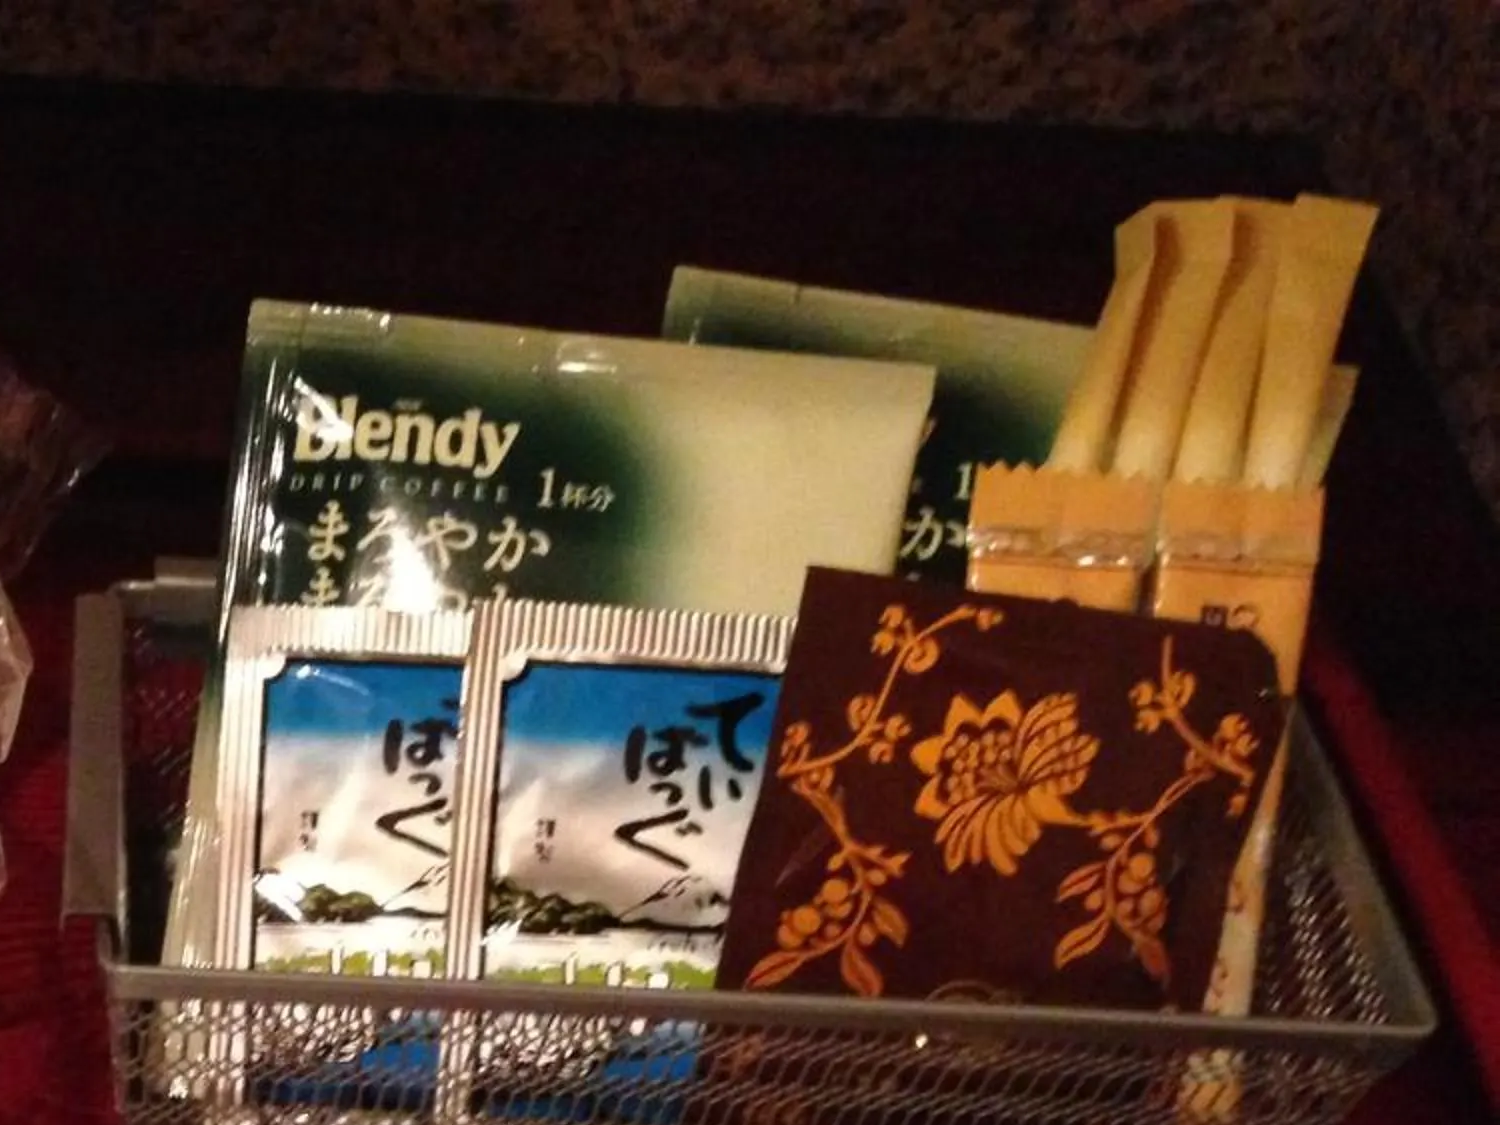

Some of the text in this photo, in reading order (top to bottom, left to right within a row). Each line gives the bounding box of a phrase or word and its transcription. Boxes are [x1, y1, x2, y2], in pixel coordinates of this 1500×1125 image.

[293, 394, 520, 479] Blendy
[288, 470, 510, 504] DRIP COFFEE
